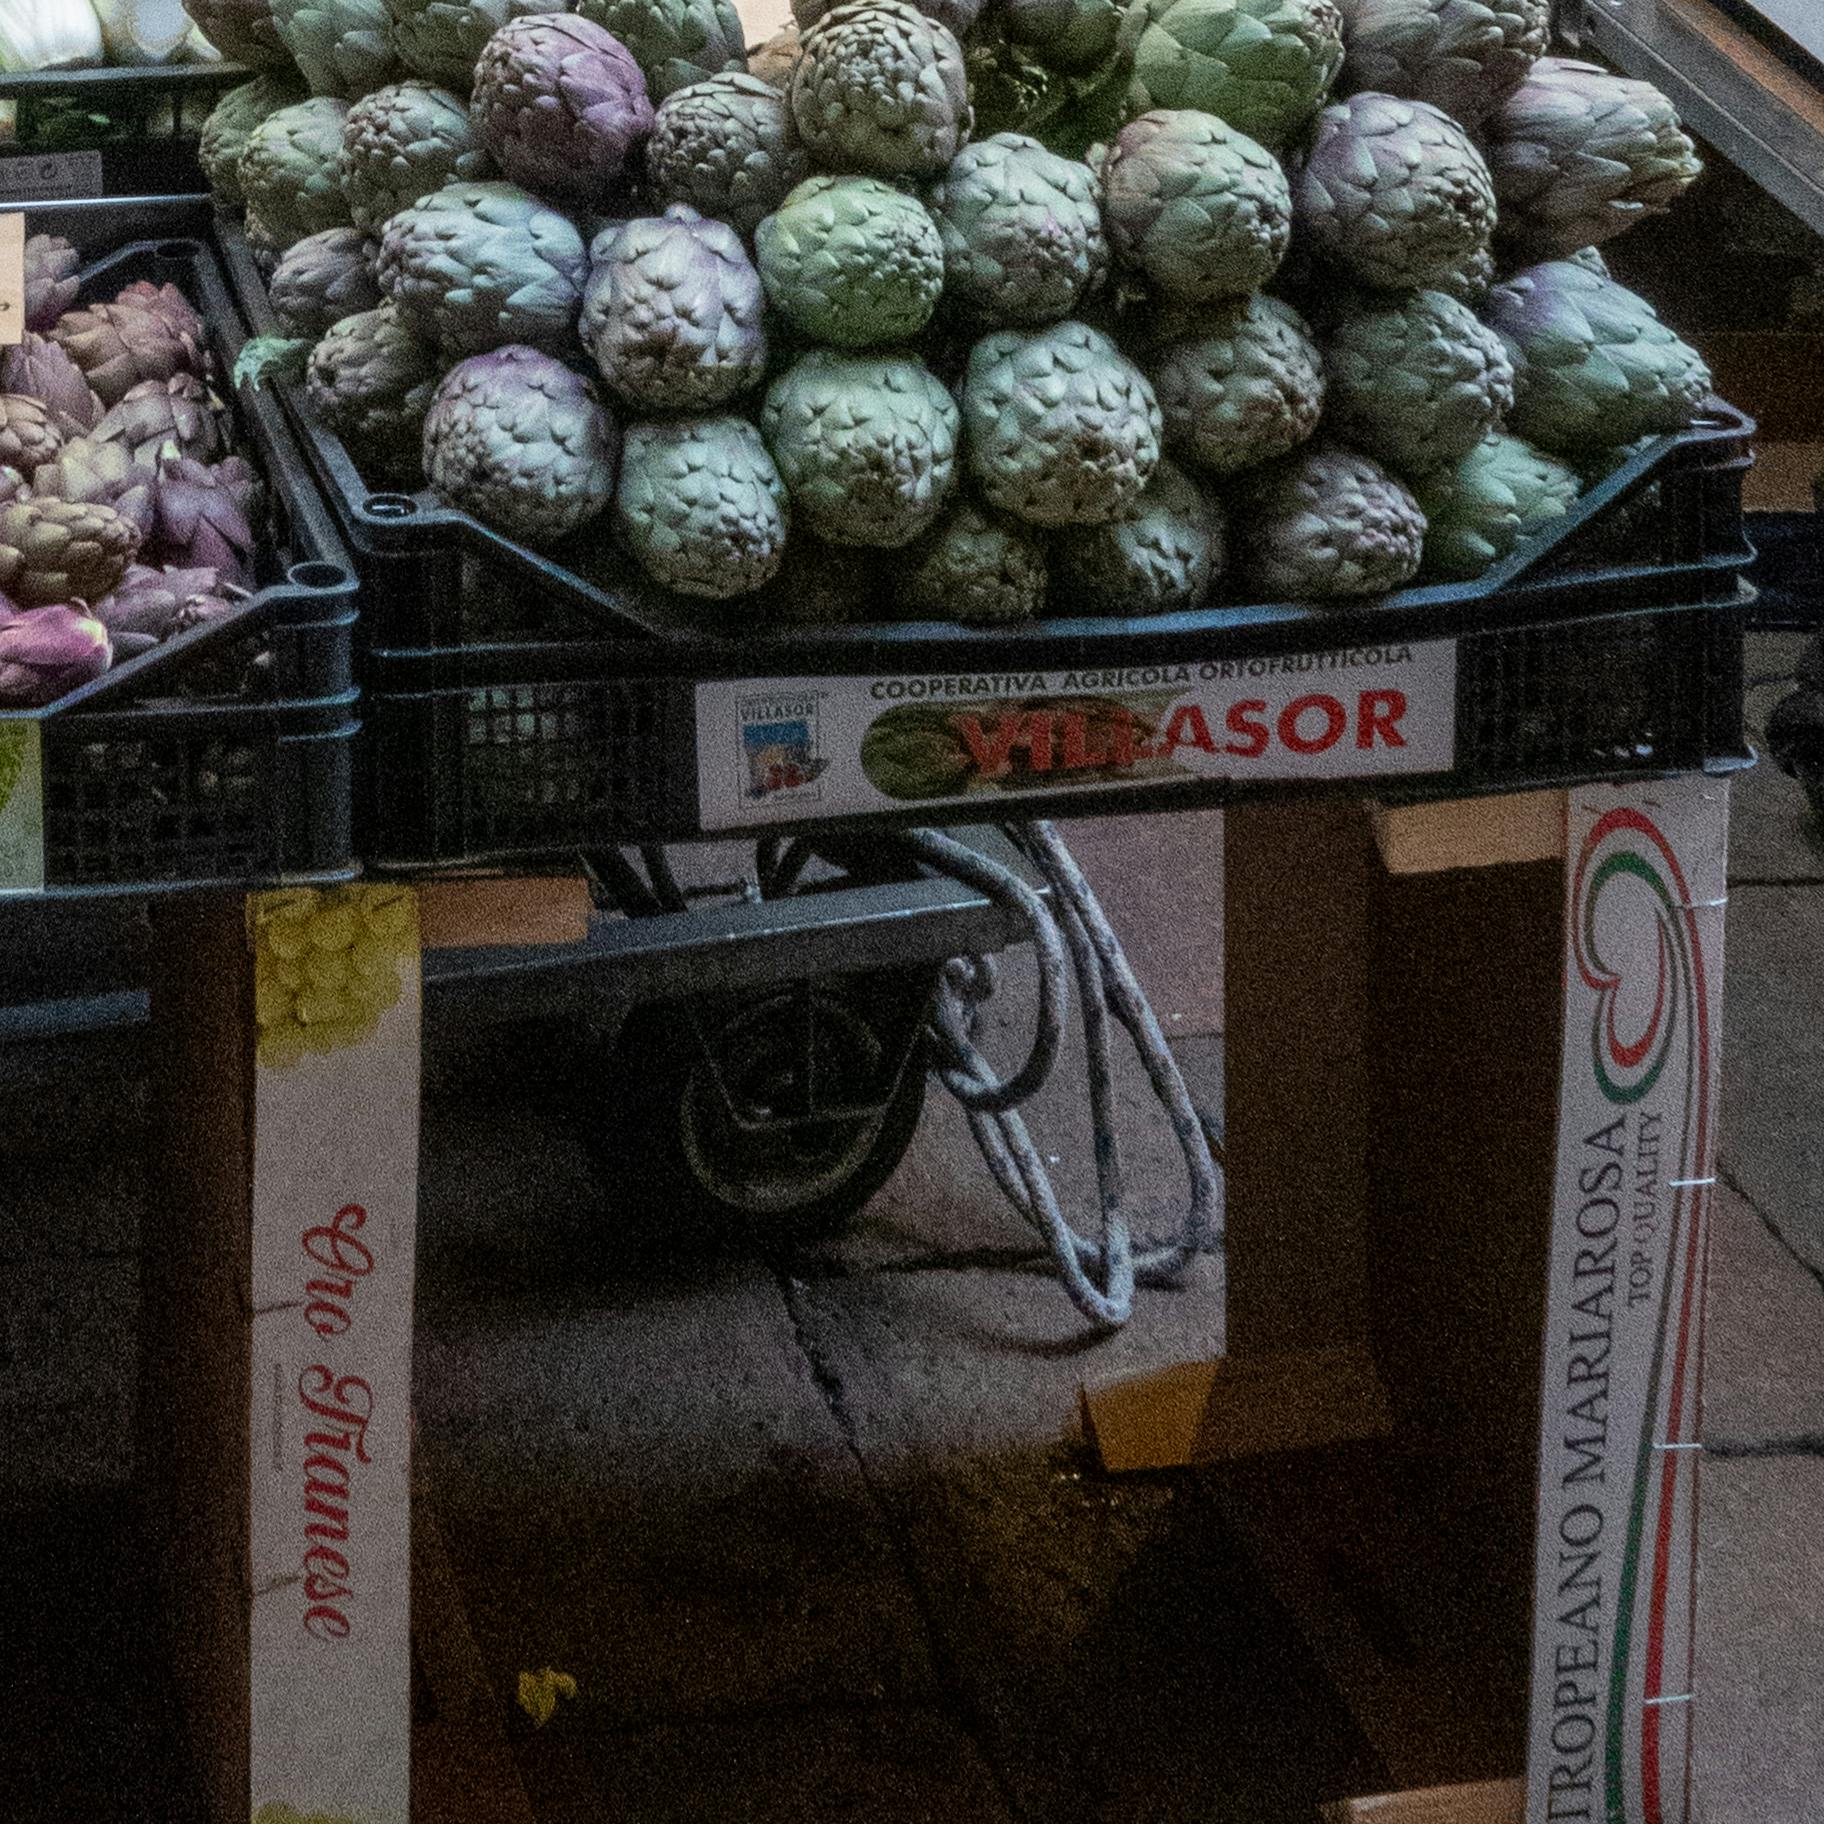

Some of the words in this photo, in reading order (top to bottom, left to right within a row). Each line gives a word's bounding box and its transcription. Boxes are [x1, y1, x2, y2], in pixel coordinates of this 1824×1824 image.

[740, 703, 816, 721] VILLASOR
[869, 671, 1049, 703] COOPERATIVA
[1061, 662, 1195, 692] AGRICOLA
[1198, 644, 1414, 684] ORTOFRUTTICOLA
[952, 687, 1409, 778] VILLASOR
[1631, 1110, 1664, 1257] QUALITY
[301, 1202, 376, 1341] Oro
[1574, 1114, 1630, 1493] MARIAROSA
[1628, 1260, 1651, 1307] TOP
[1546, 1502, 1607, 1824] TROPEANO
